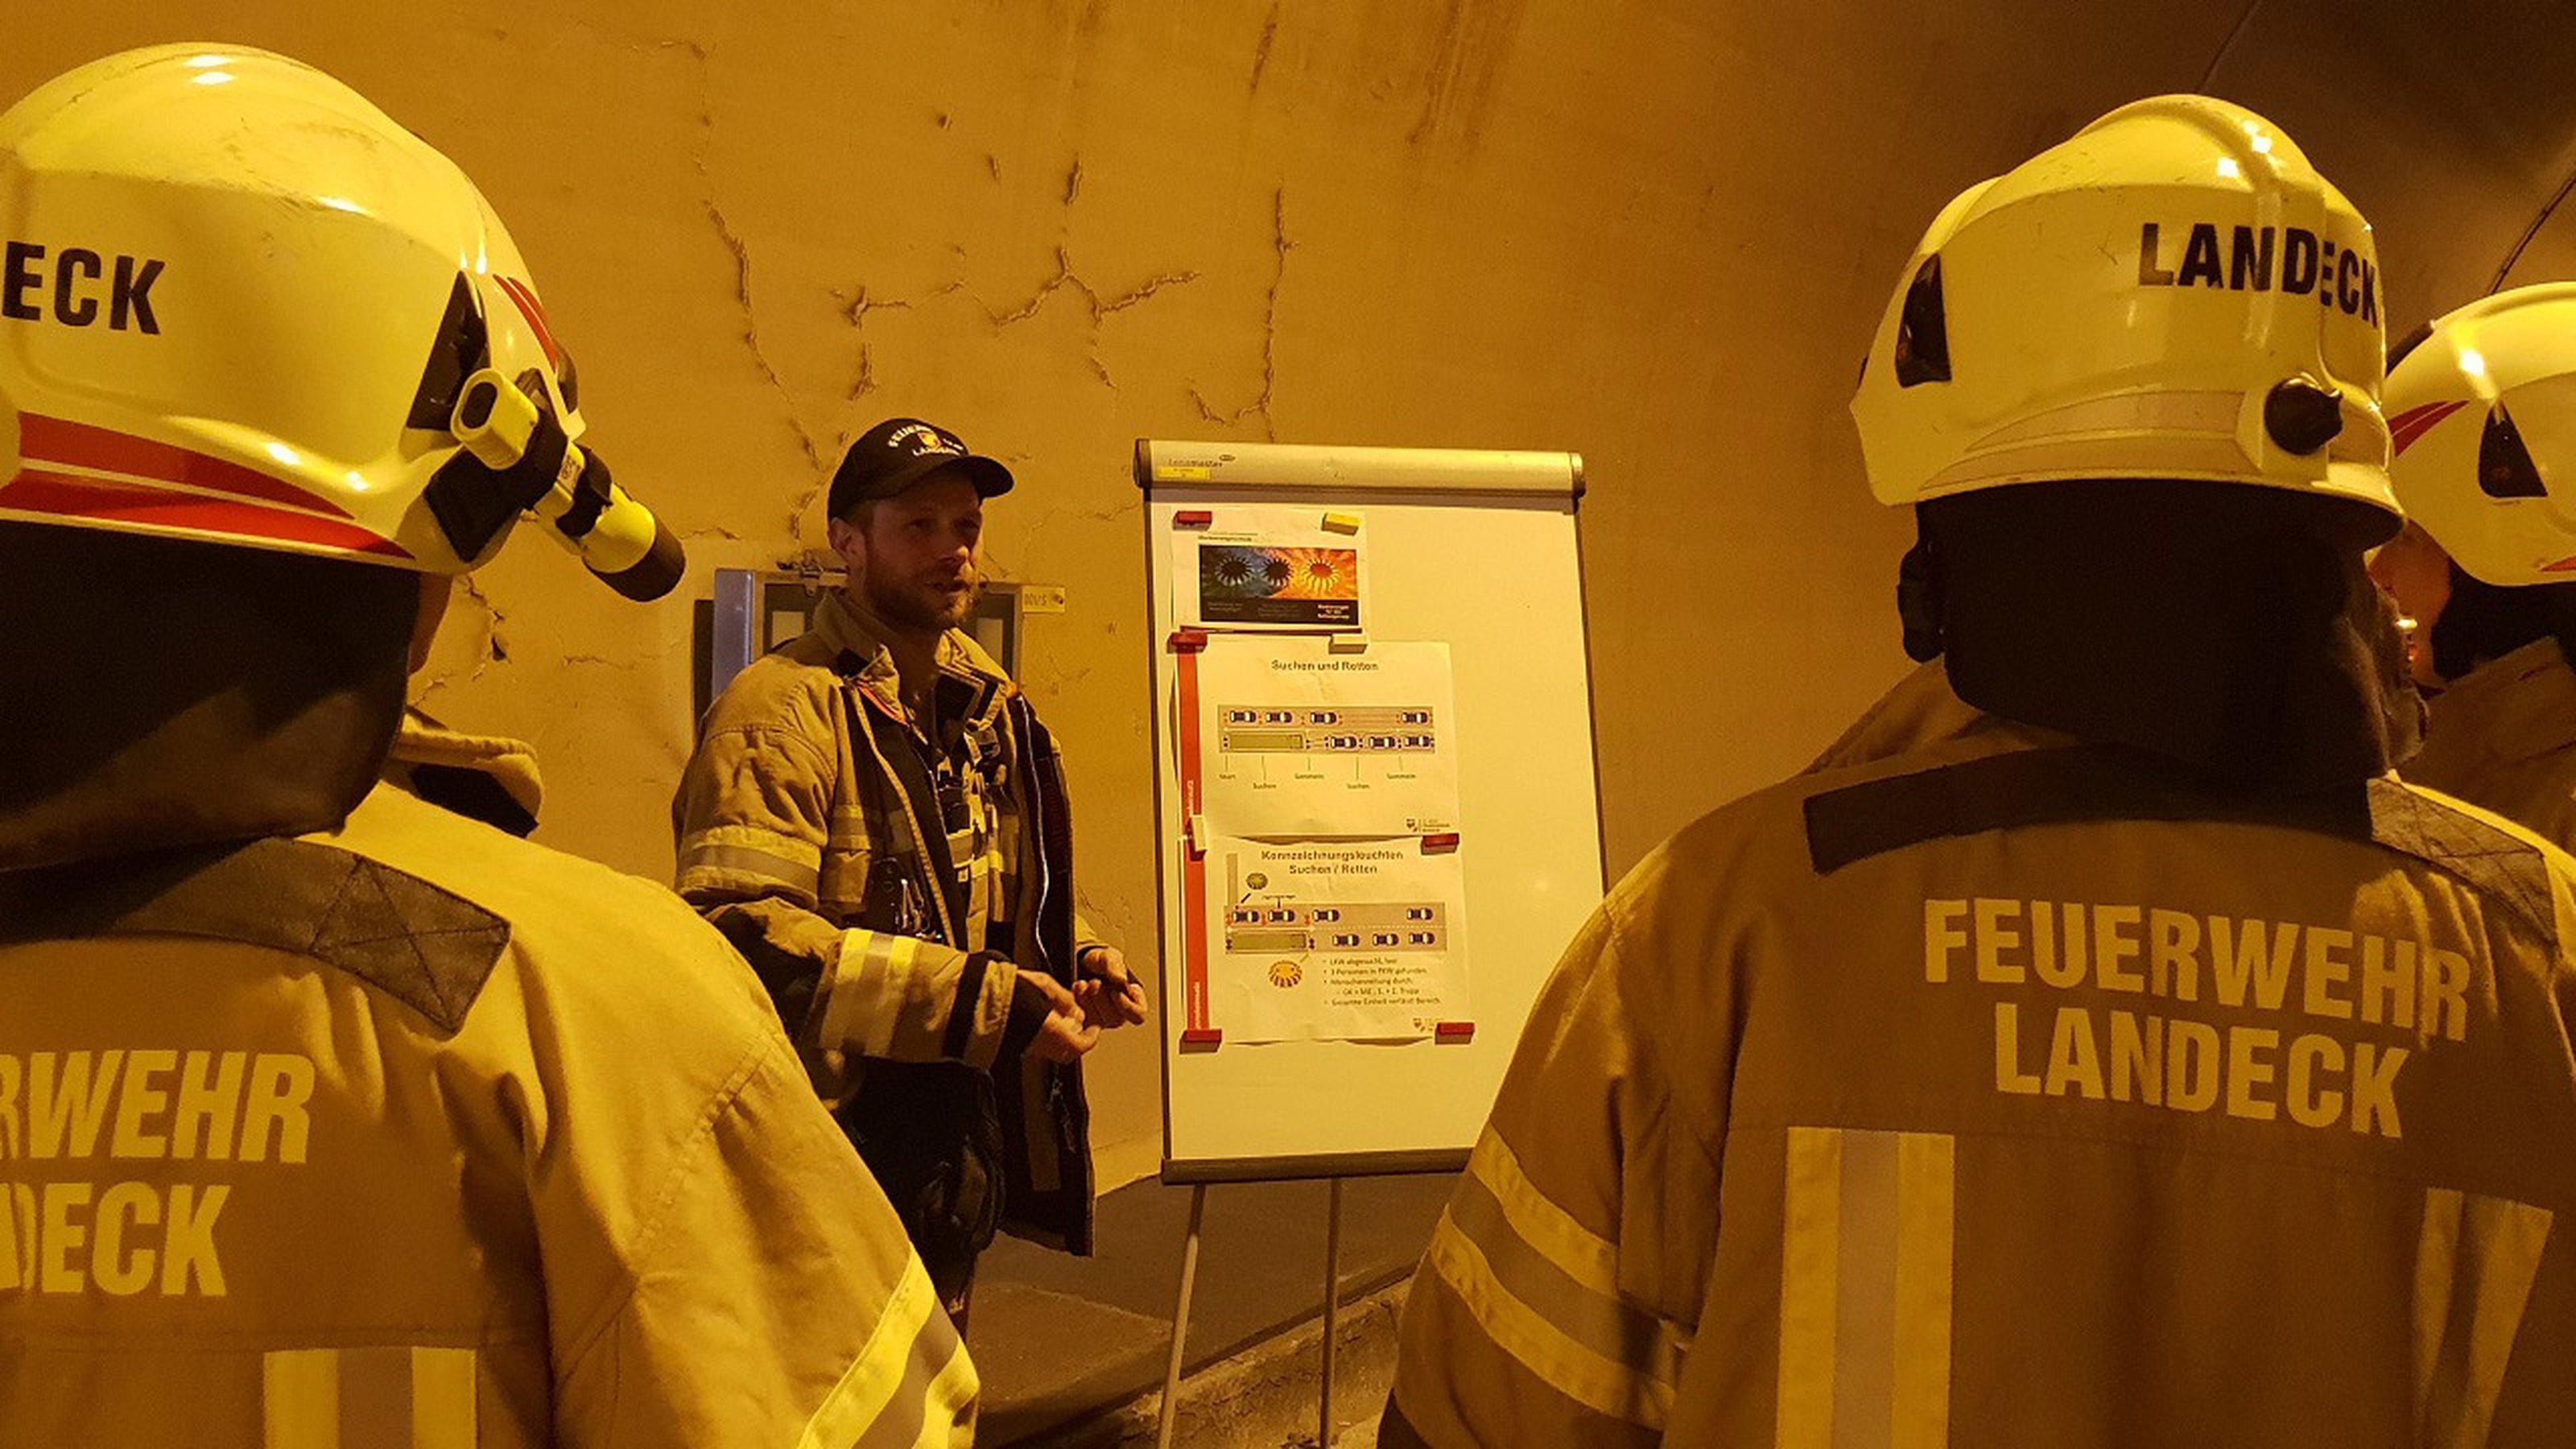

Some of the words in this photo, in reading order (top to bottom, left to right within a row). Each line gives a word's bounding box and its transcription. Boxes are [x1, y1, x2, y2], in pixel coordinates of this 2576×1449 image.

[2, 241, 166, 335] ECK
[2138, 222, 2378, 328] LANDECK
[1317, 661, 1340, 671] und
[1925, 898, 2470, 1042] FEUERWEHR
[1995, 1002, 2410, 1138] LANDECK
